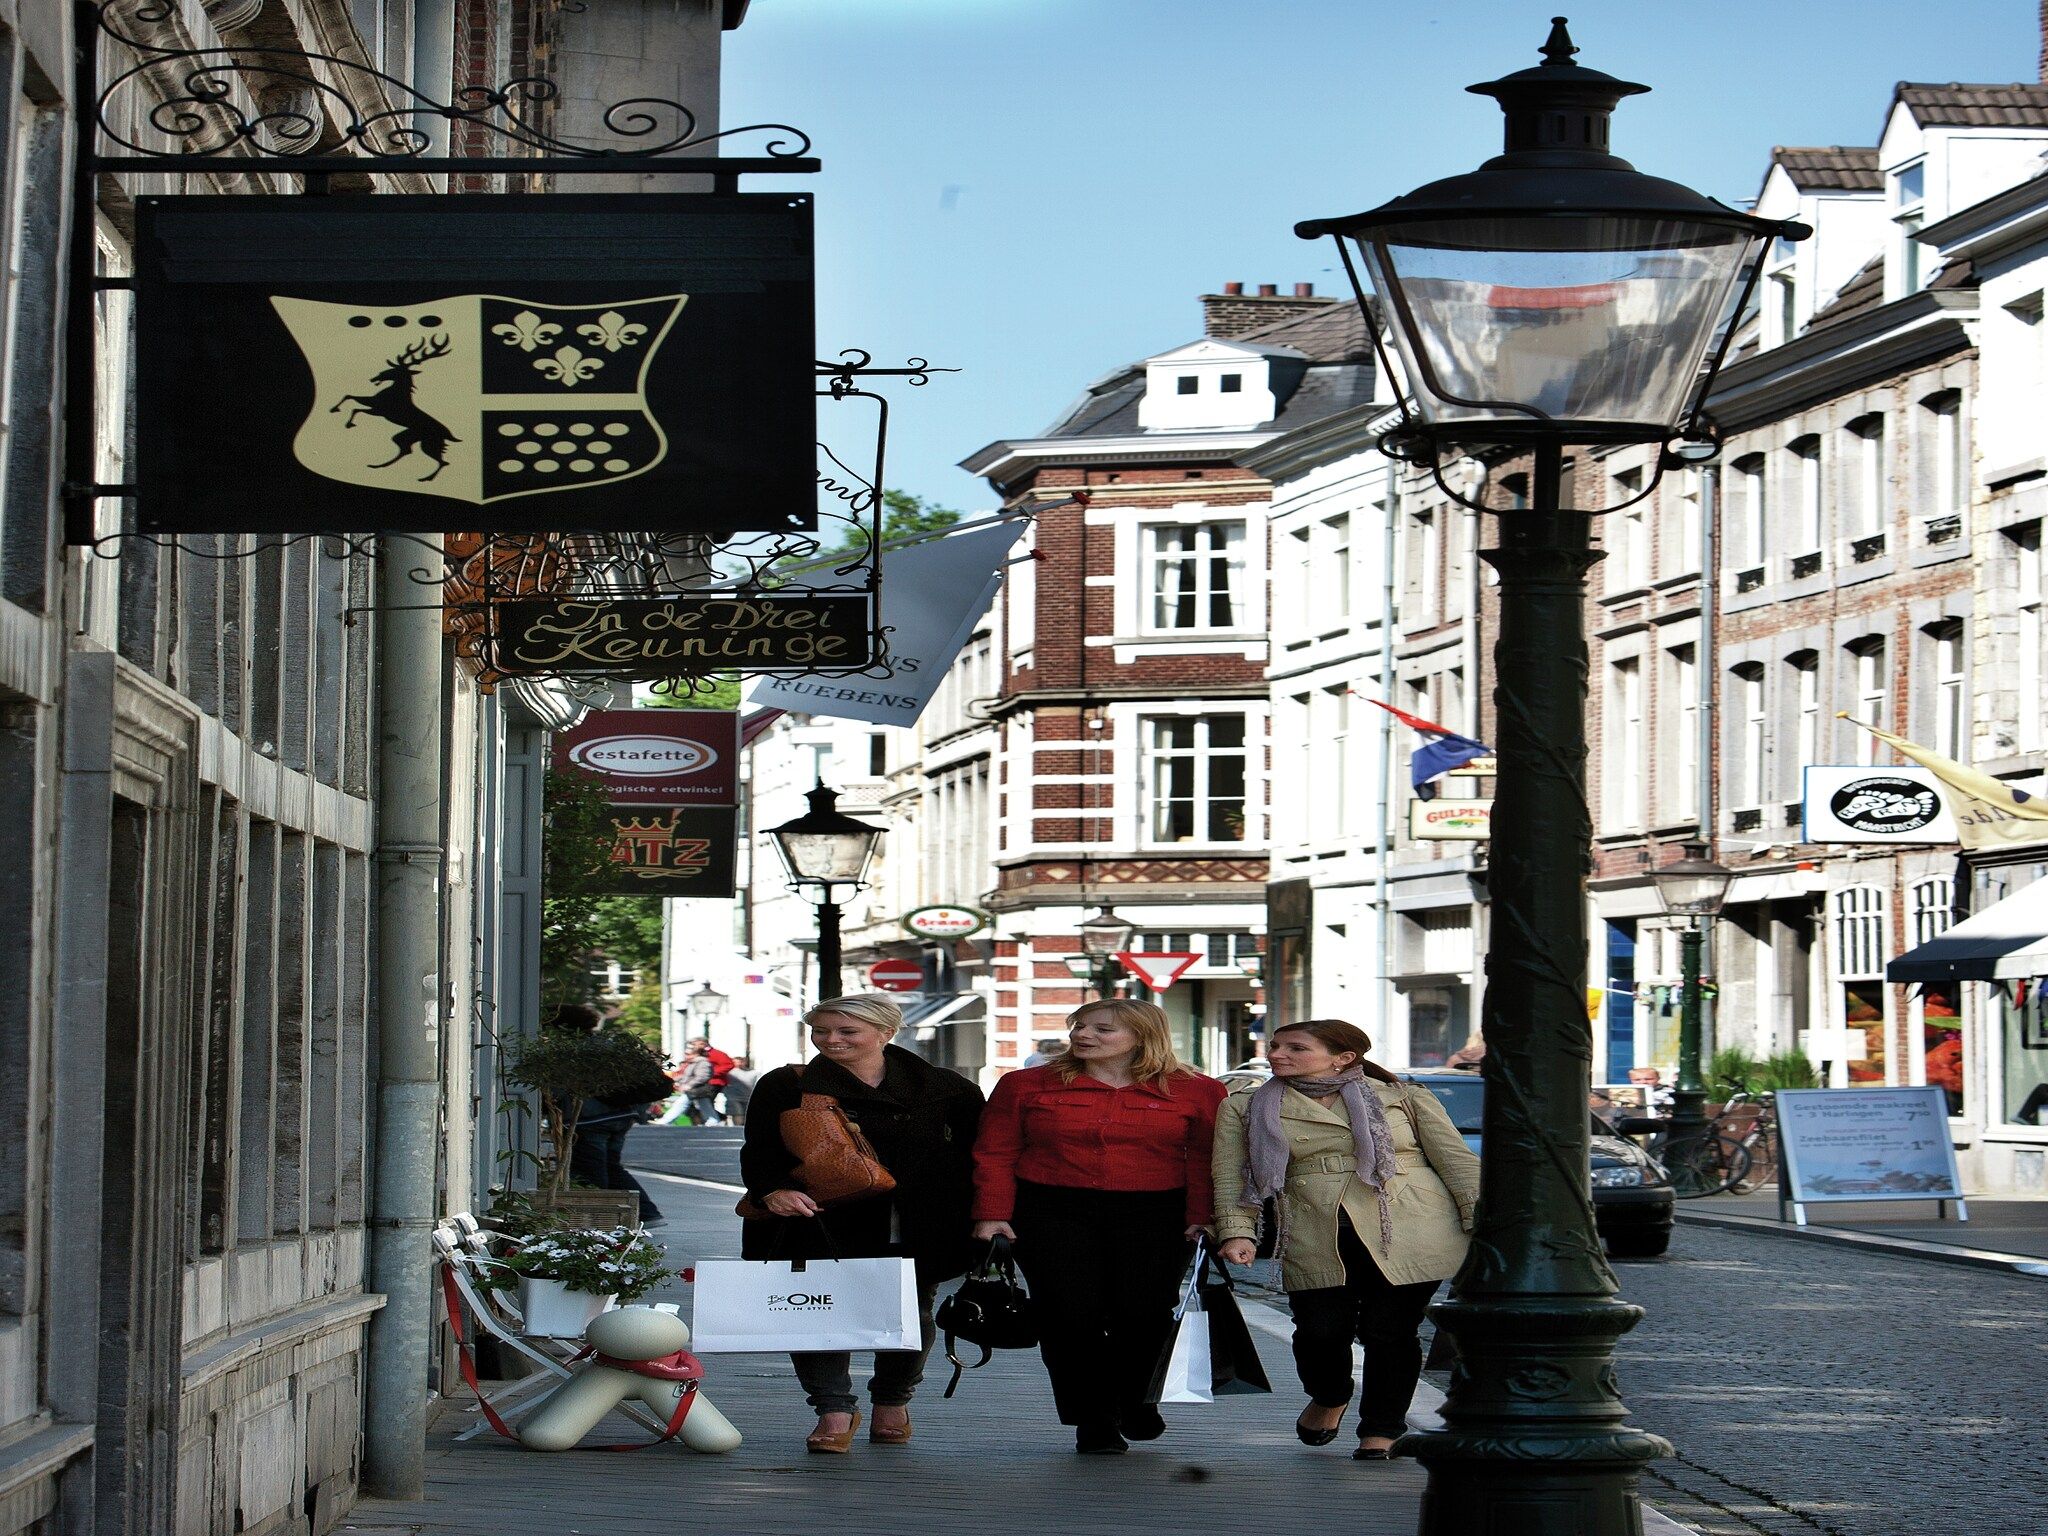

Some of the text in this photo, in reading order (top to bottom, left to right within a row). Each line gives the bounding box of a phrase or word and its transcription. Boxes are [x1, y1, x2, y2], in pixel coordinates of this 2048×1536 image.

[540, 601, 835, 633] In de Drei
[514, 628, 848, 664] Keuninge
[771, 678, 919, 709] RUEBENS
[592, 749, 696, 762] estafette
[661, 784, 724, 795] eetwinkel
[1853, 816, 1926, 834] MAASTRICHT
[586, 836, 711, 867] ATZ
[1873, 1101, 1929, 1109] makreel
[787, 1293, 834, 1306] ONE
